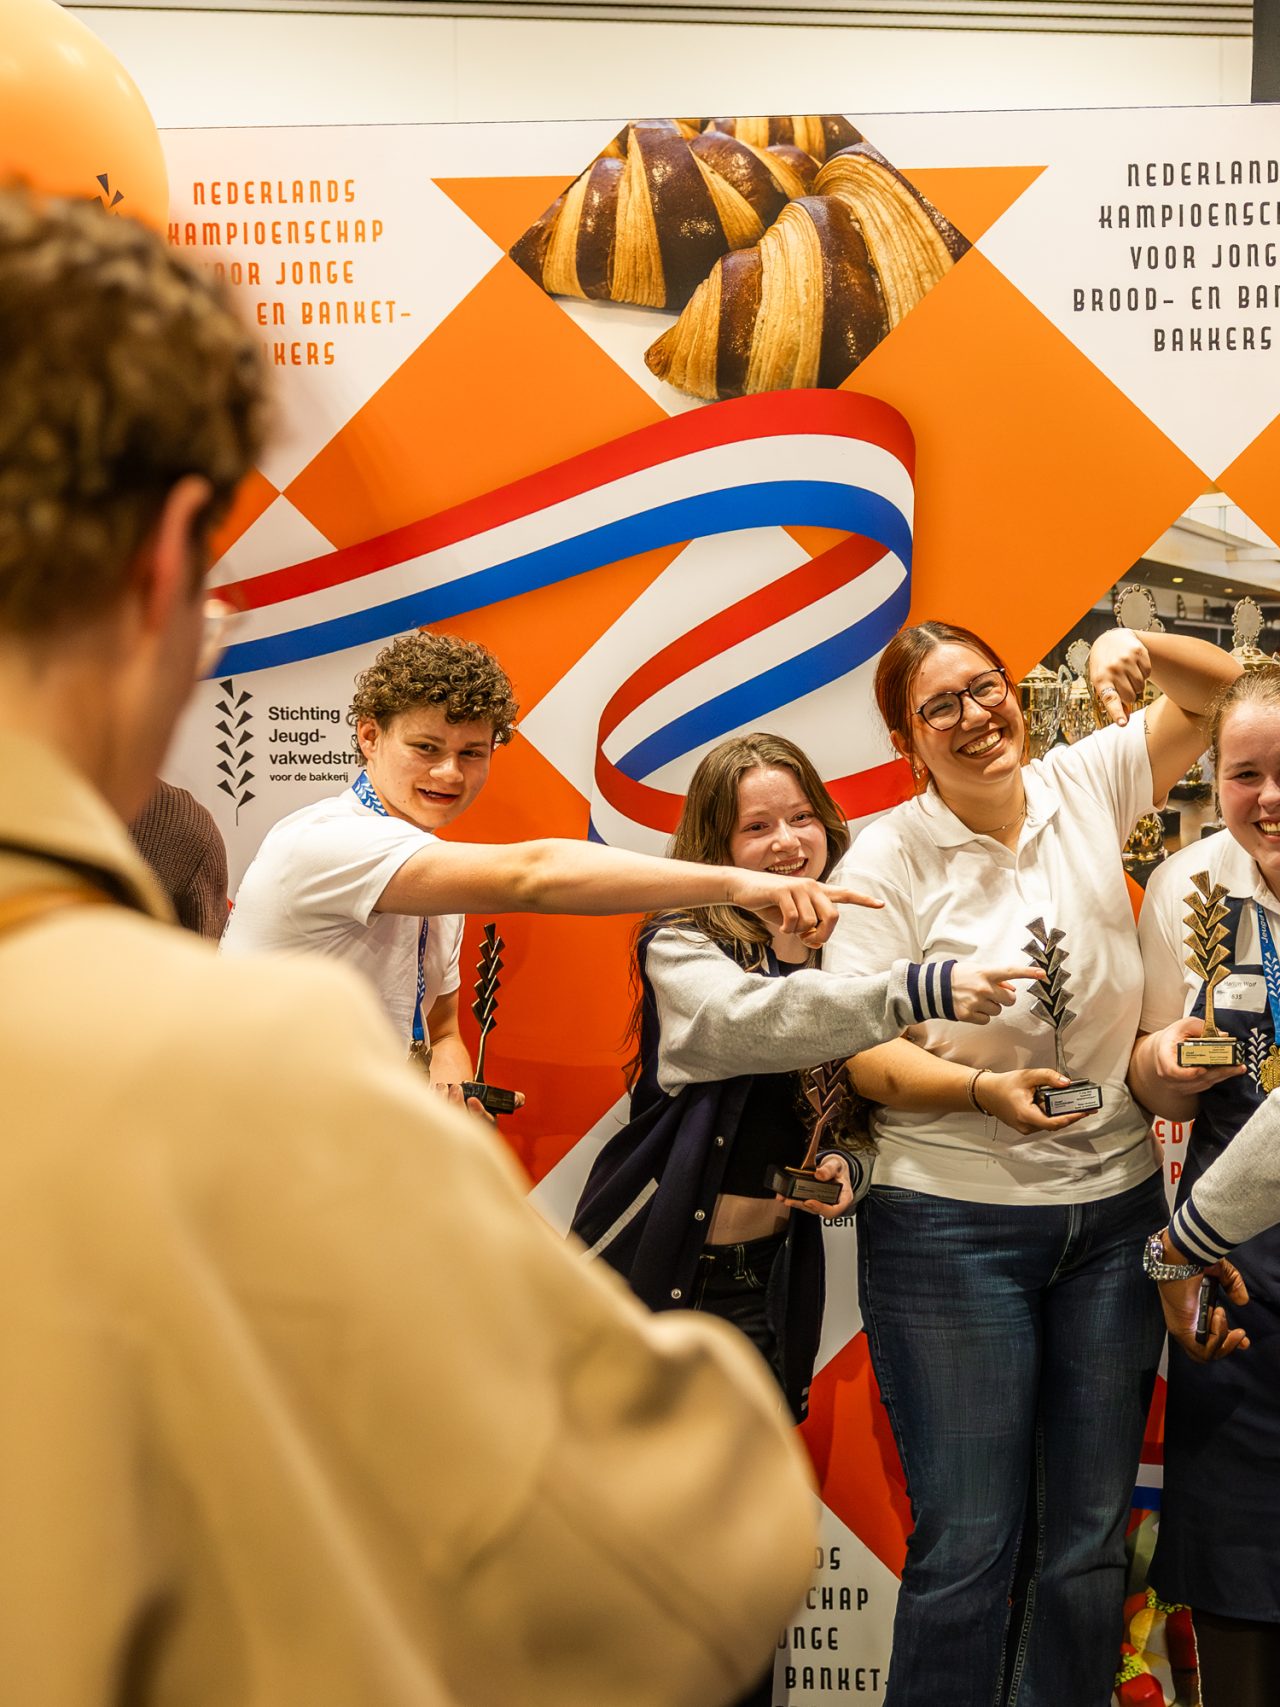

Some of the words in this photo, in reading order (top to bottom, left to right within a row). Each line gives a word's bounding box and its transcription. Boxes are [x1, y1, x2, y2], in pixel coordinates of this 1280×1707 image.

[193, 179, 357, 206] NEDERLANDS
[167, 219, 385, 246] KAMPIOENSCHAP
[1130, 244, 1196, 270] VOOR
[205, 261, 261, 286] OOR
[275, 260, 355, 285] JONGE
[1073, 287, 1175, 312] BROOD-
[1191, 286, 1221, 310] EN
[256, 301, 286, 326] EN
[302, 300, 412, 325] BANKET-
[1154, 326, 1273, 352] BAKKERS
[263, 341, 336, 367] KERS
[268, 706, 341, 724] Stichting
[268, 728, 327, 745] Jeugd-
[269, 774, 293, 782] voor
[294, 772, 308, 782] de
[309, 772, 349, 783] bakkerij
[777, 1626, 839, 1651] ONGE
[785, 1666, 888, 1692] BANKET
